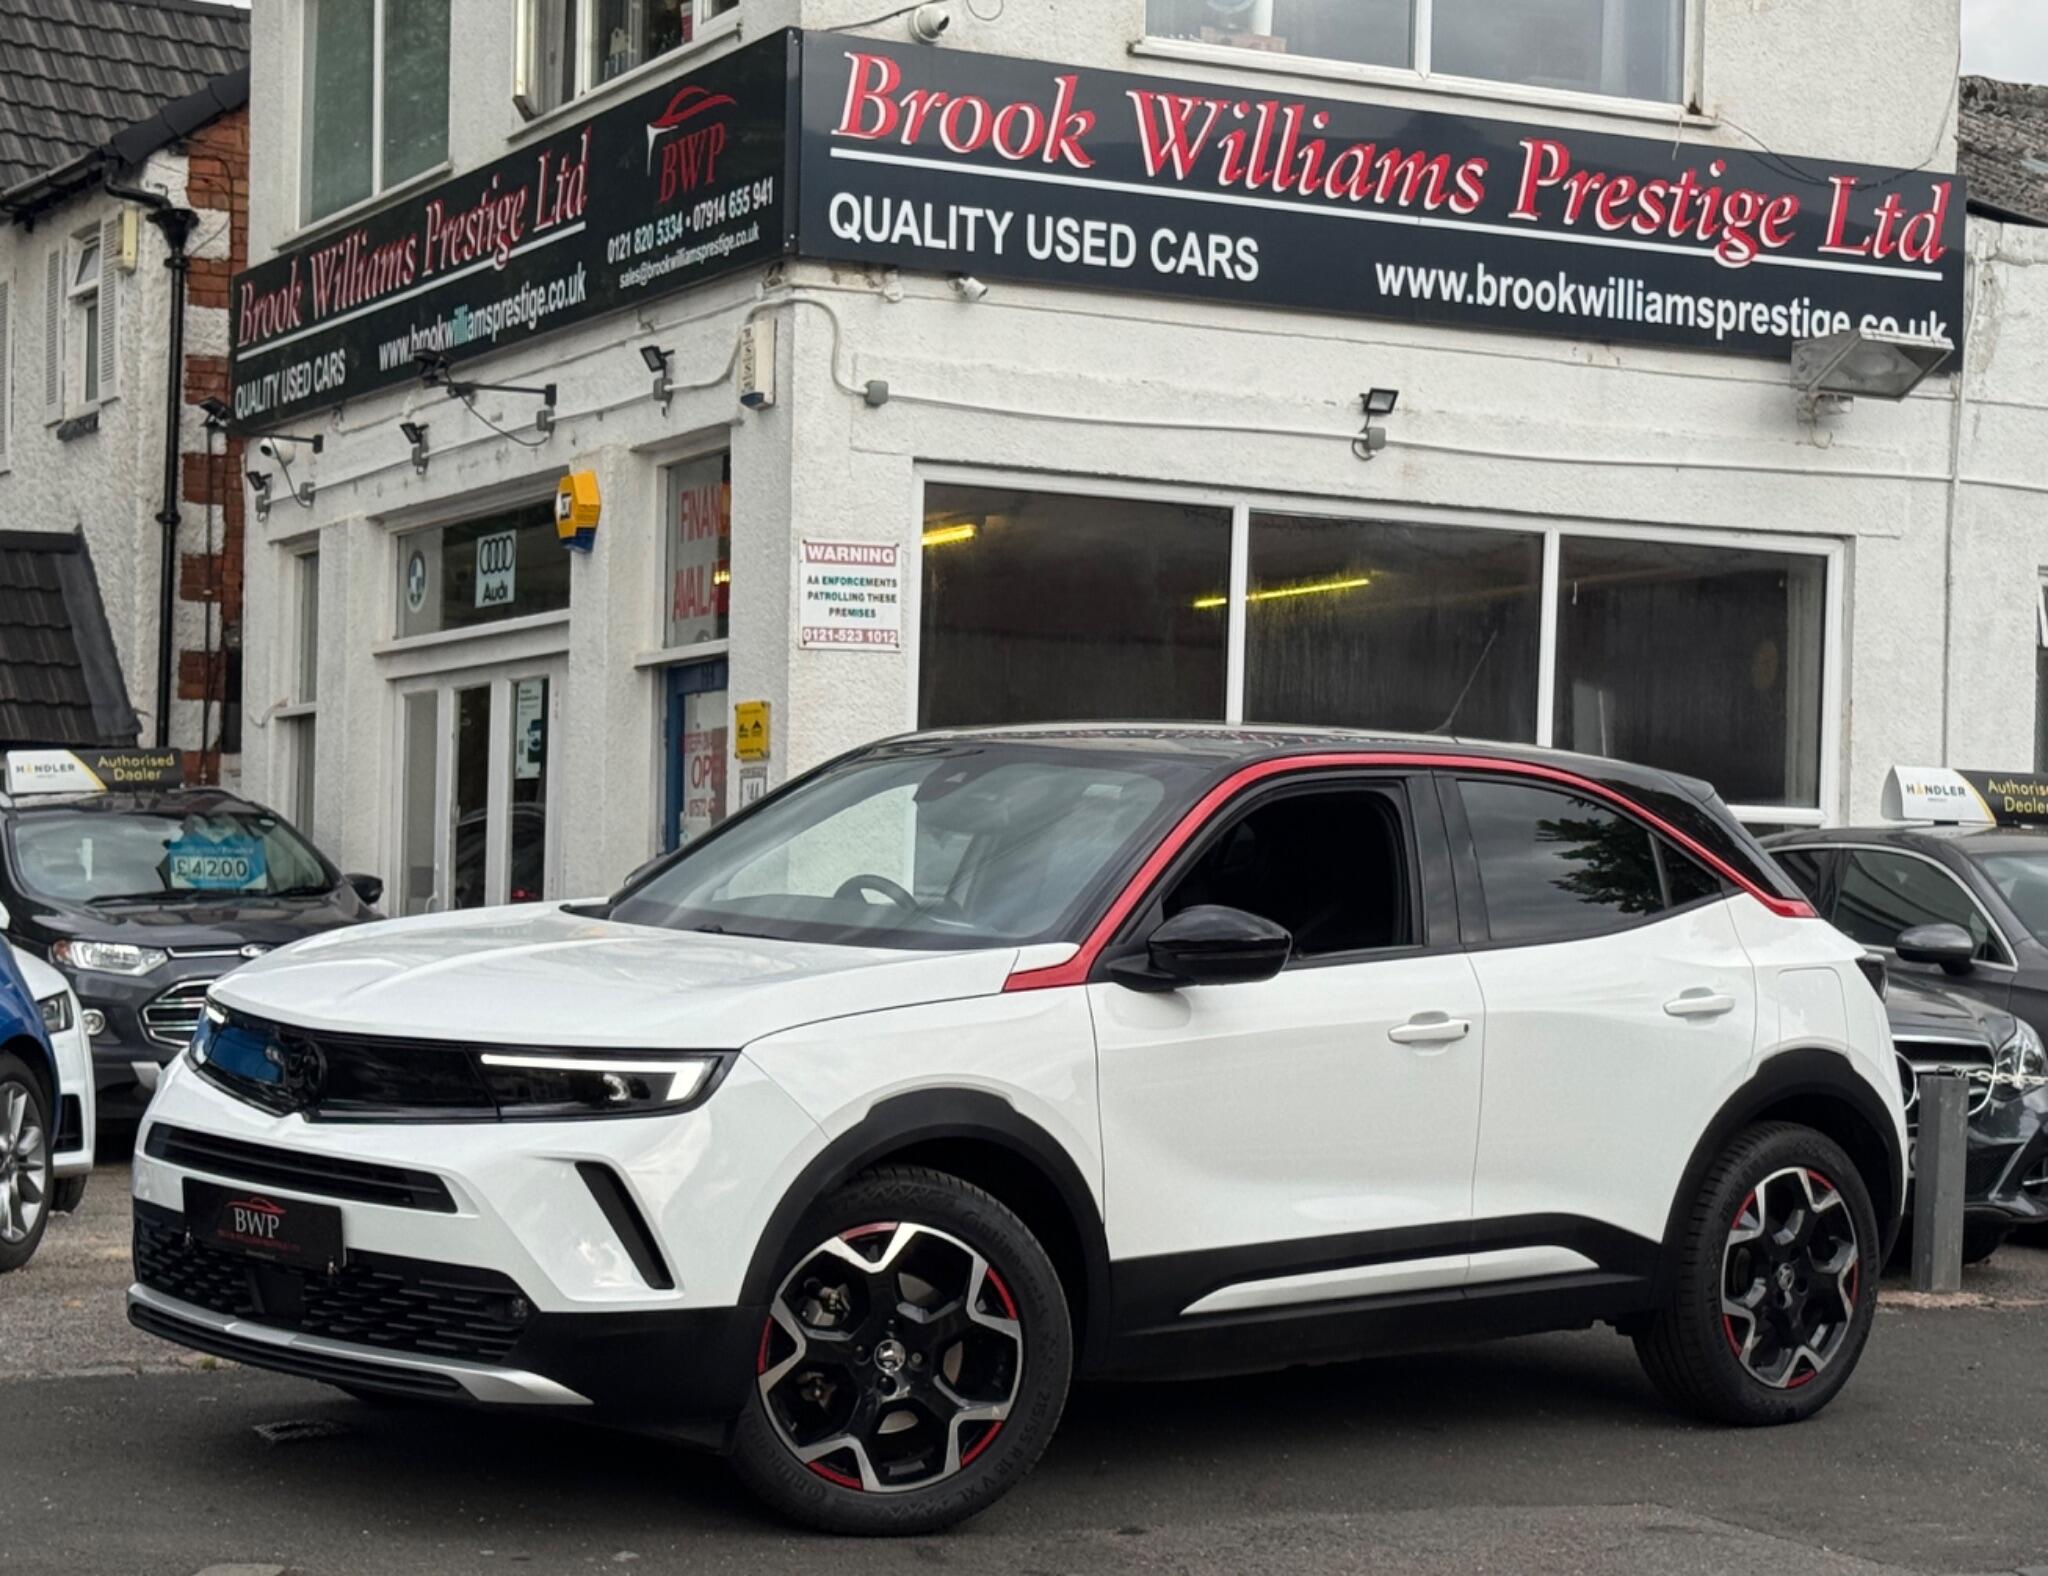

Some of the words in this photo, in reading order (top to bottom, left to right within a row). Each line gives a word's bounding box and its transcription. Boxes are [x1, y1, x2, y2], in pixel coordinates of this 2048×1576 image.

[659, 122, 727, 204] BWP
[830, 50, 1097, 169] Brook
[1125, 88, 1489, 215] Williams
[1508, 136, 1801, 268] Prestige
[1817, 173, 1953, 265] Ltd
[607, 231, 632, 264] 0121
[633, 224, 655, 255] 820
[656, 211, 684, 246] 5334
[693, 194, 726, 232] 07914
[728, 185, 751, 219] 655
[752, 176, 774, 210] 941
[237, 256, 304, 347] Brook
[310, 229, 416, 320] Williams
[422, 172, 528, 271] Prestige
[533, 126, 592, 233] Ltd
[828, 191, 1014, 255] QUALITY
[1025, 213, 1137, 269] USED
[1150, 226, 1260, 282] CARS
[1375, 261, 1947, 340] www.brookwilliamsprestigecouk
[235, 367, 282, 420] QUALITY
[281, 360, 312, 399] USED
[313, 348, 347, 394] CARS
[807, 545, 895, 564] WARNING
[807, 575, 820, 585] AA
[822, 576, 898, 588] ENFORCEMENTS
[482, 582, 509, 603] Audi
[807, 591, 865, 602] PATROLLING
[867, 593, 897, 604] THESE
[829, 607, 877, 618] PREMISES
[803, 628, 863, 642] 0121-523
[866, 630, 897, 643] 1012
[97, 753, 175, 769] Authorised
[113, 768, 162, 782] Dealer
[1987, 778, 2048, 796] Authoris
[175, 859, 248, 878] £4200
[234, 1207, 280, 1238] BWP
